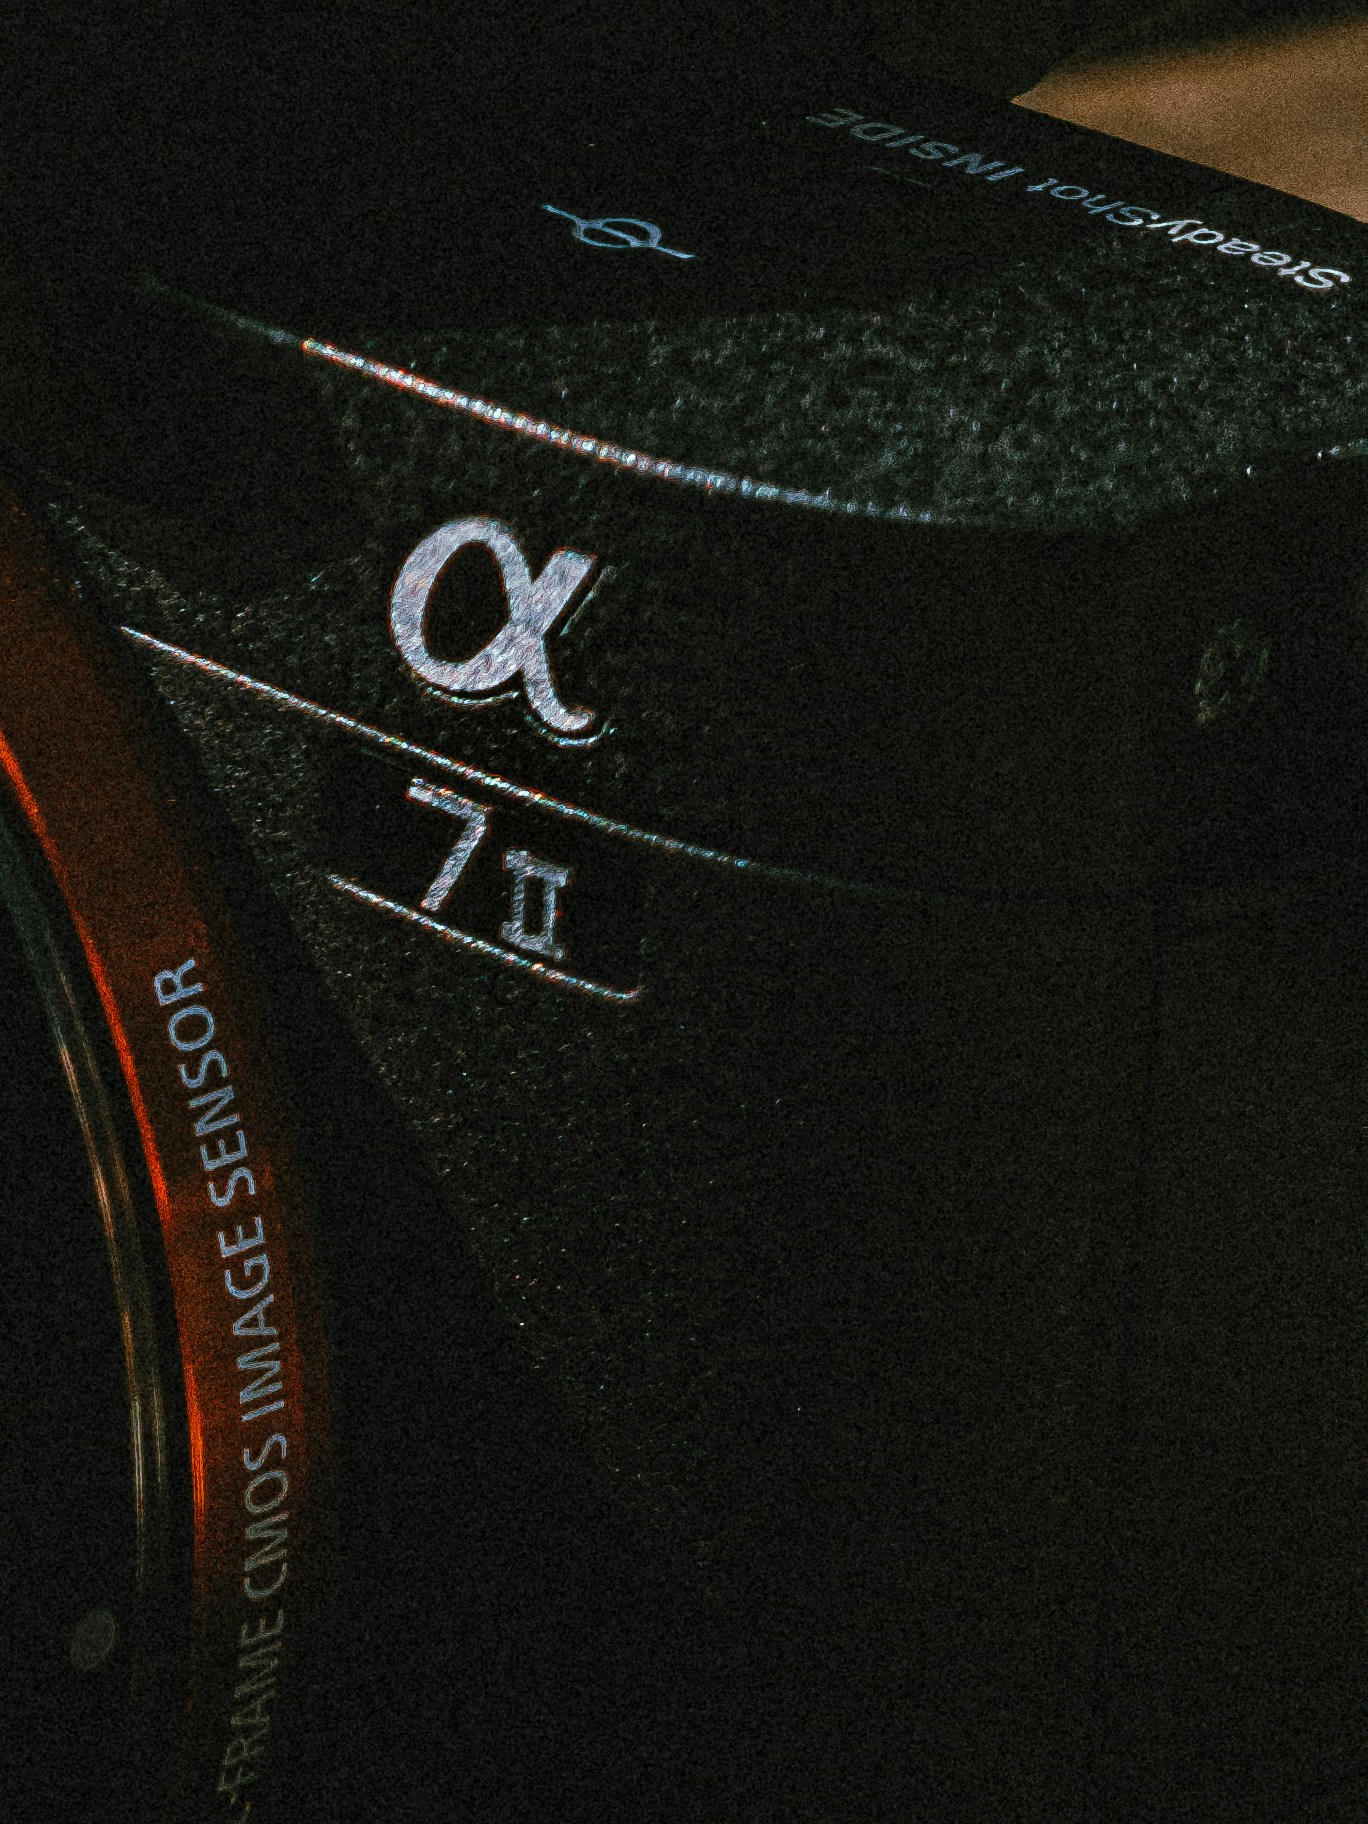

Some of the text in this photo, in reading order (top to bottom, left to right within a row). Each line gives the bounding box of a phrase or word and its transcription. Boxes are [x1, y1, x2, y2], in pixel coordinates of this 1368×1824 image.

[806, 107, 1351, 291] SteadyShot INSIDE
[153, 956, 256, 1208] SENSOR
[216, 1216, 286, 1423] IMAGE
[243, 1432, 290, 1601] CMOS
